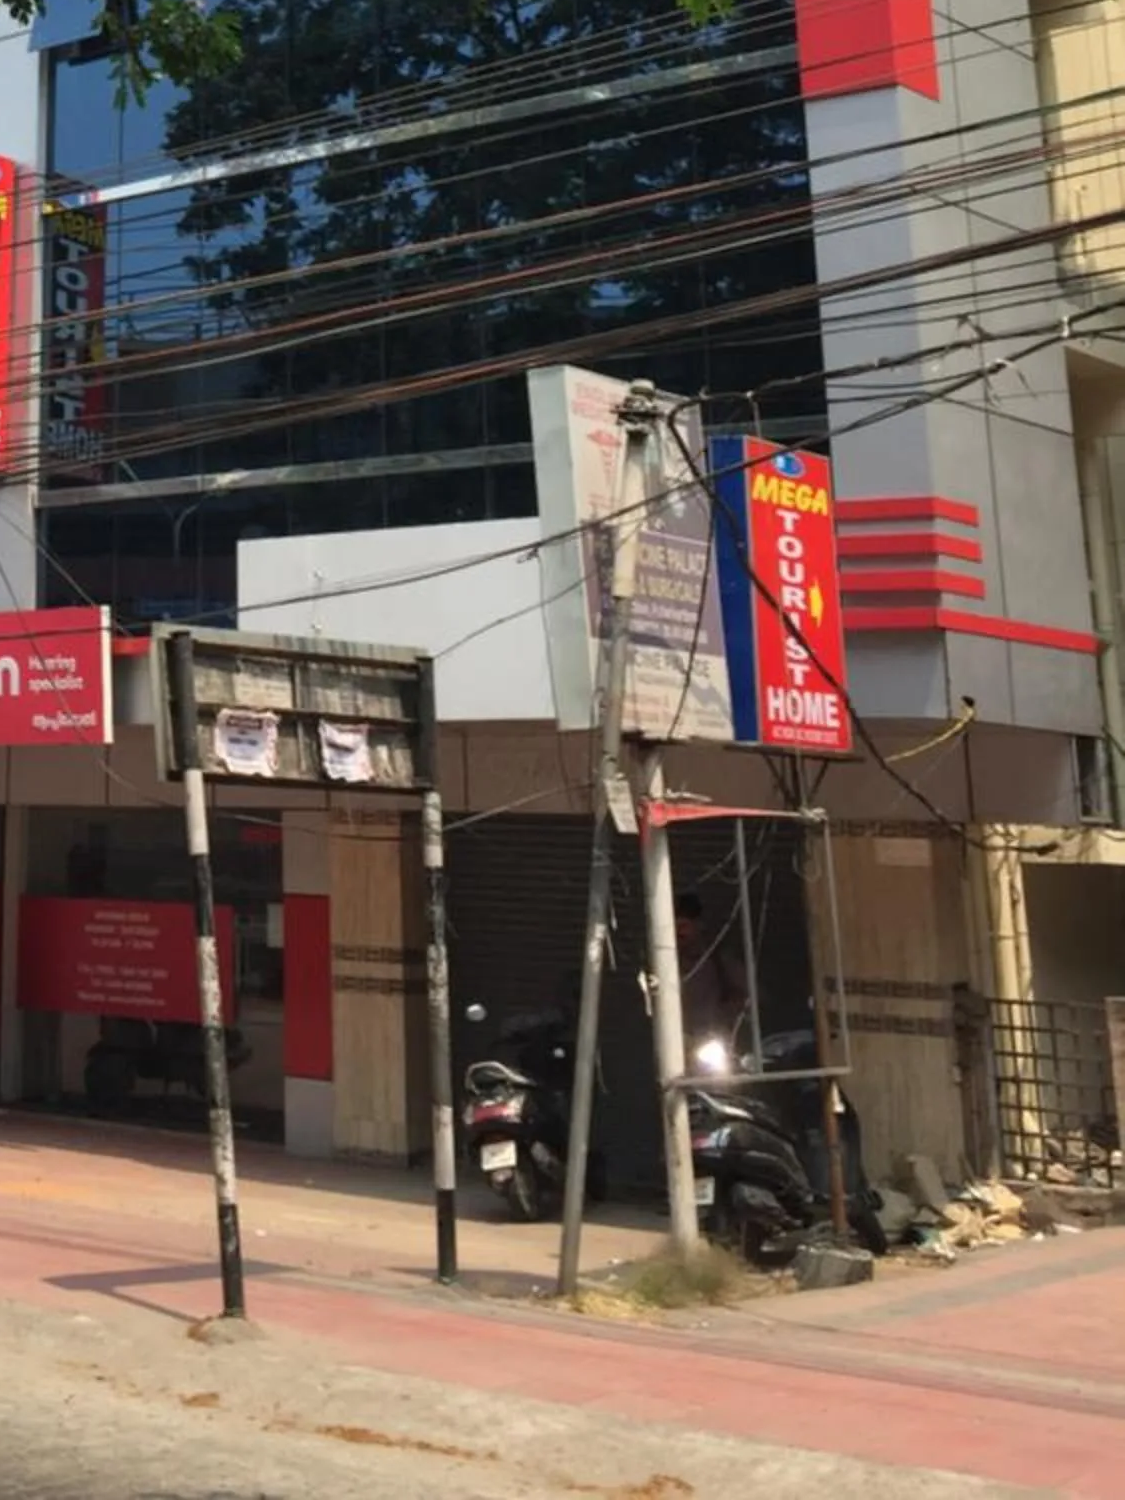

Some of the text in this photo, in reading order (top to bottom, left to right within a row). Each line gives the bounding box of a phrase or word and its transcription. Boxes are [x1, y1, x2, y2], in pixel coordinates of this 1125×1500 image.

[751, 472, 829, 516] MEGA
[775, 509, 811, 686] TOURIST
[766, 685, 841, 729] HOME
